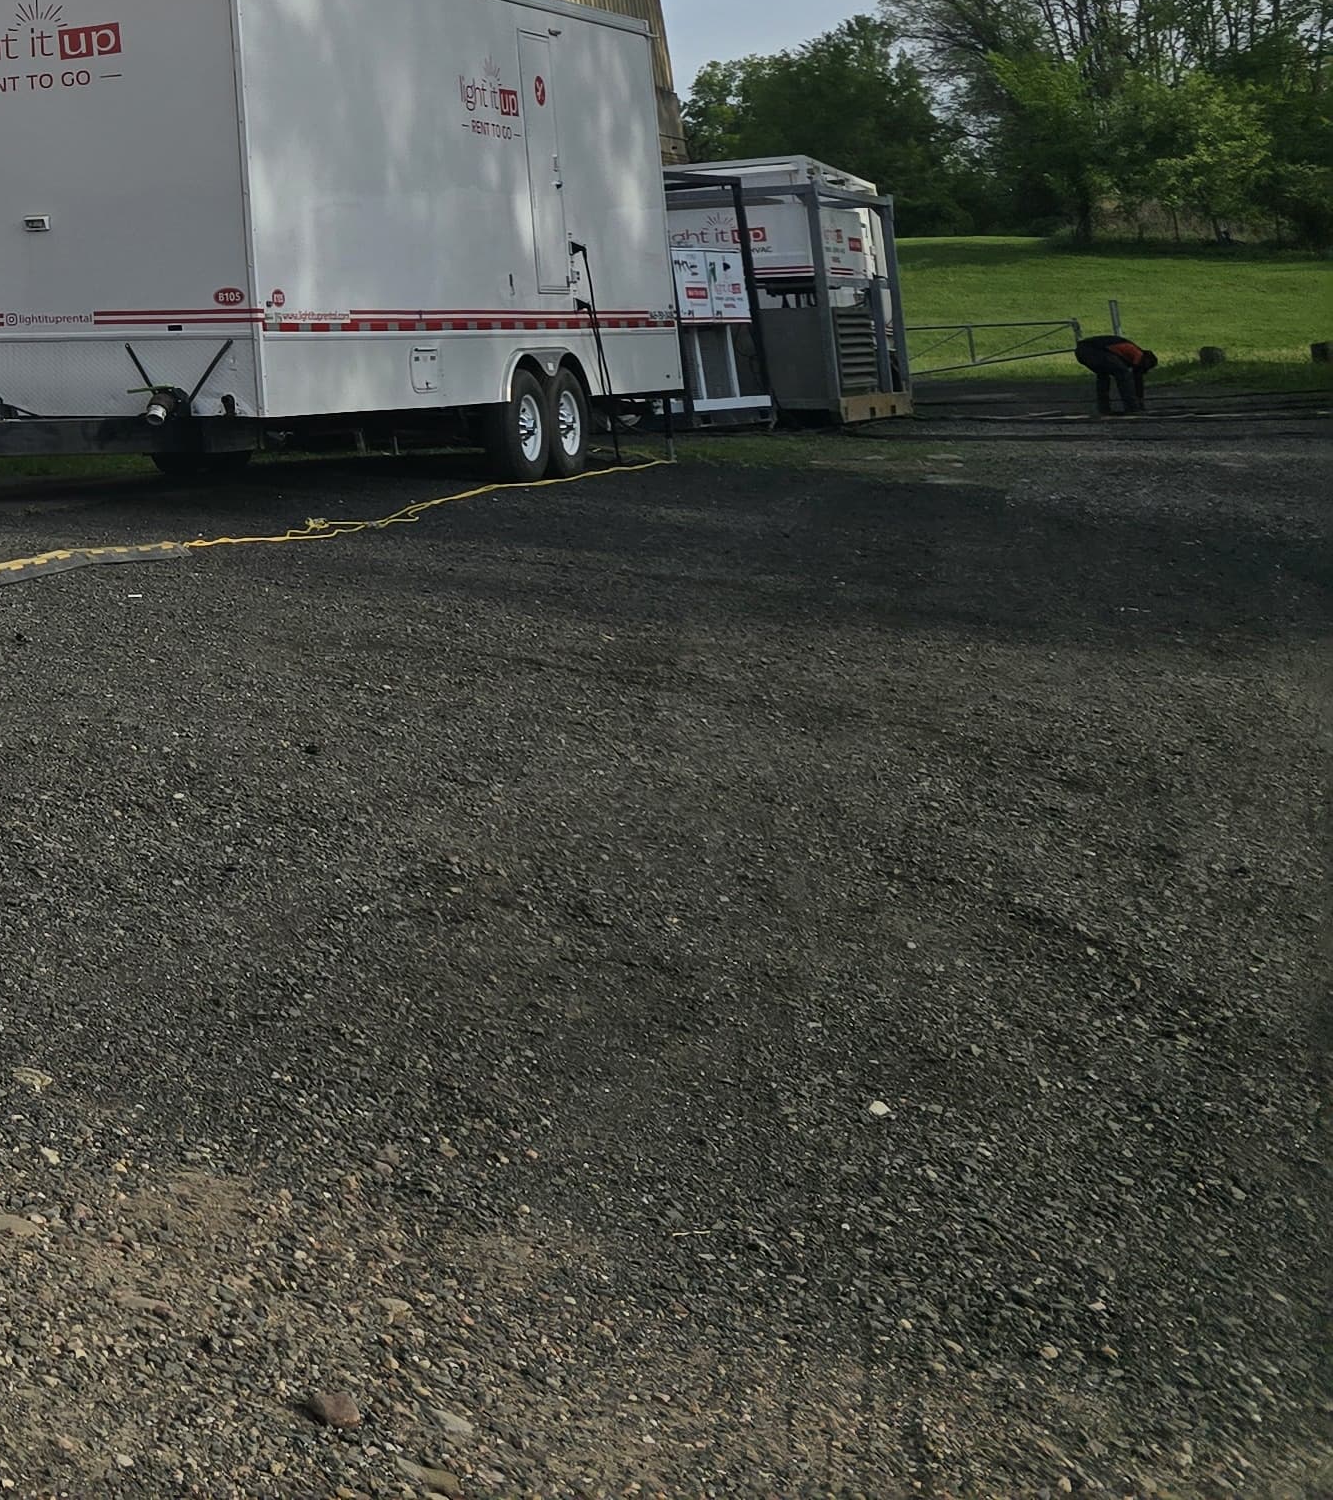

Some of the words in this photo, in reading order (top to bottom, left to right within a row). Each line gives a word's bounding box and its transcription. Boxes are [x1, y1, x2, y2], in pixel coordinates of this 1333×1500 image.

[30, 27, 54, 58] it
[63, 27, 117, 56] up
[26, 72, 54, 90] TO
[60, 69, 91, 87] GO
[458, 74, 488, 112] light
[490, 82, 500, 110] it
[500, 91, 518, 116] up
[471, 119, 490, 136] RENT
[491, 123, 501, 138] TO
[218, 291, 242, 302] B105
[19, 312, 93, 326] lightituprental
